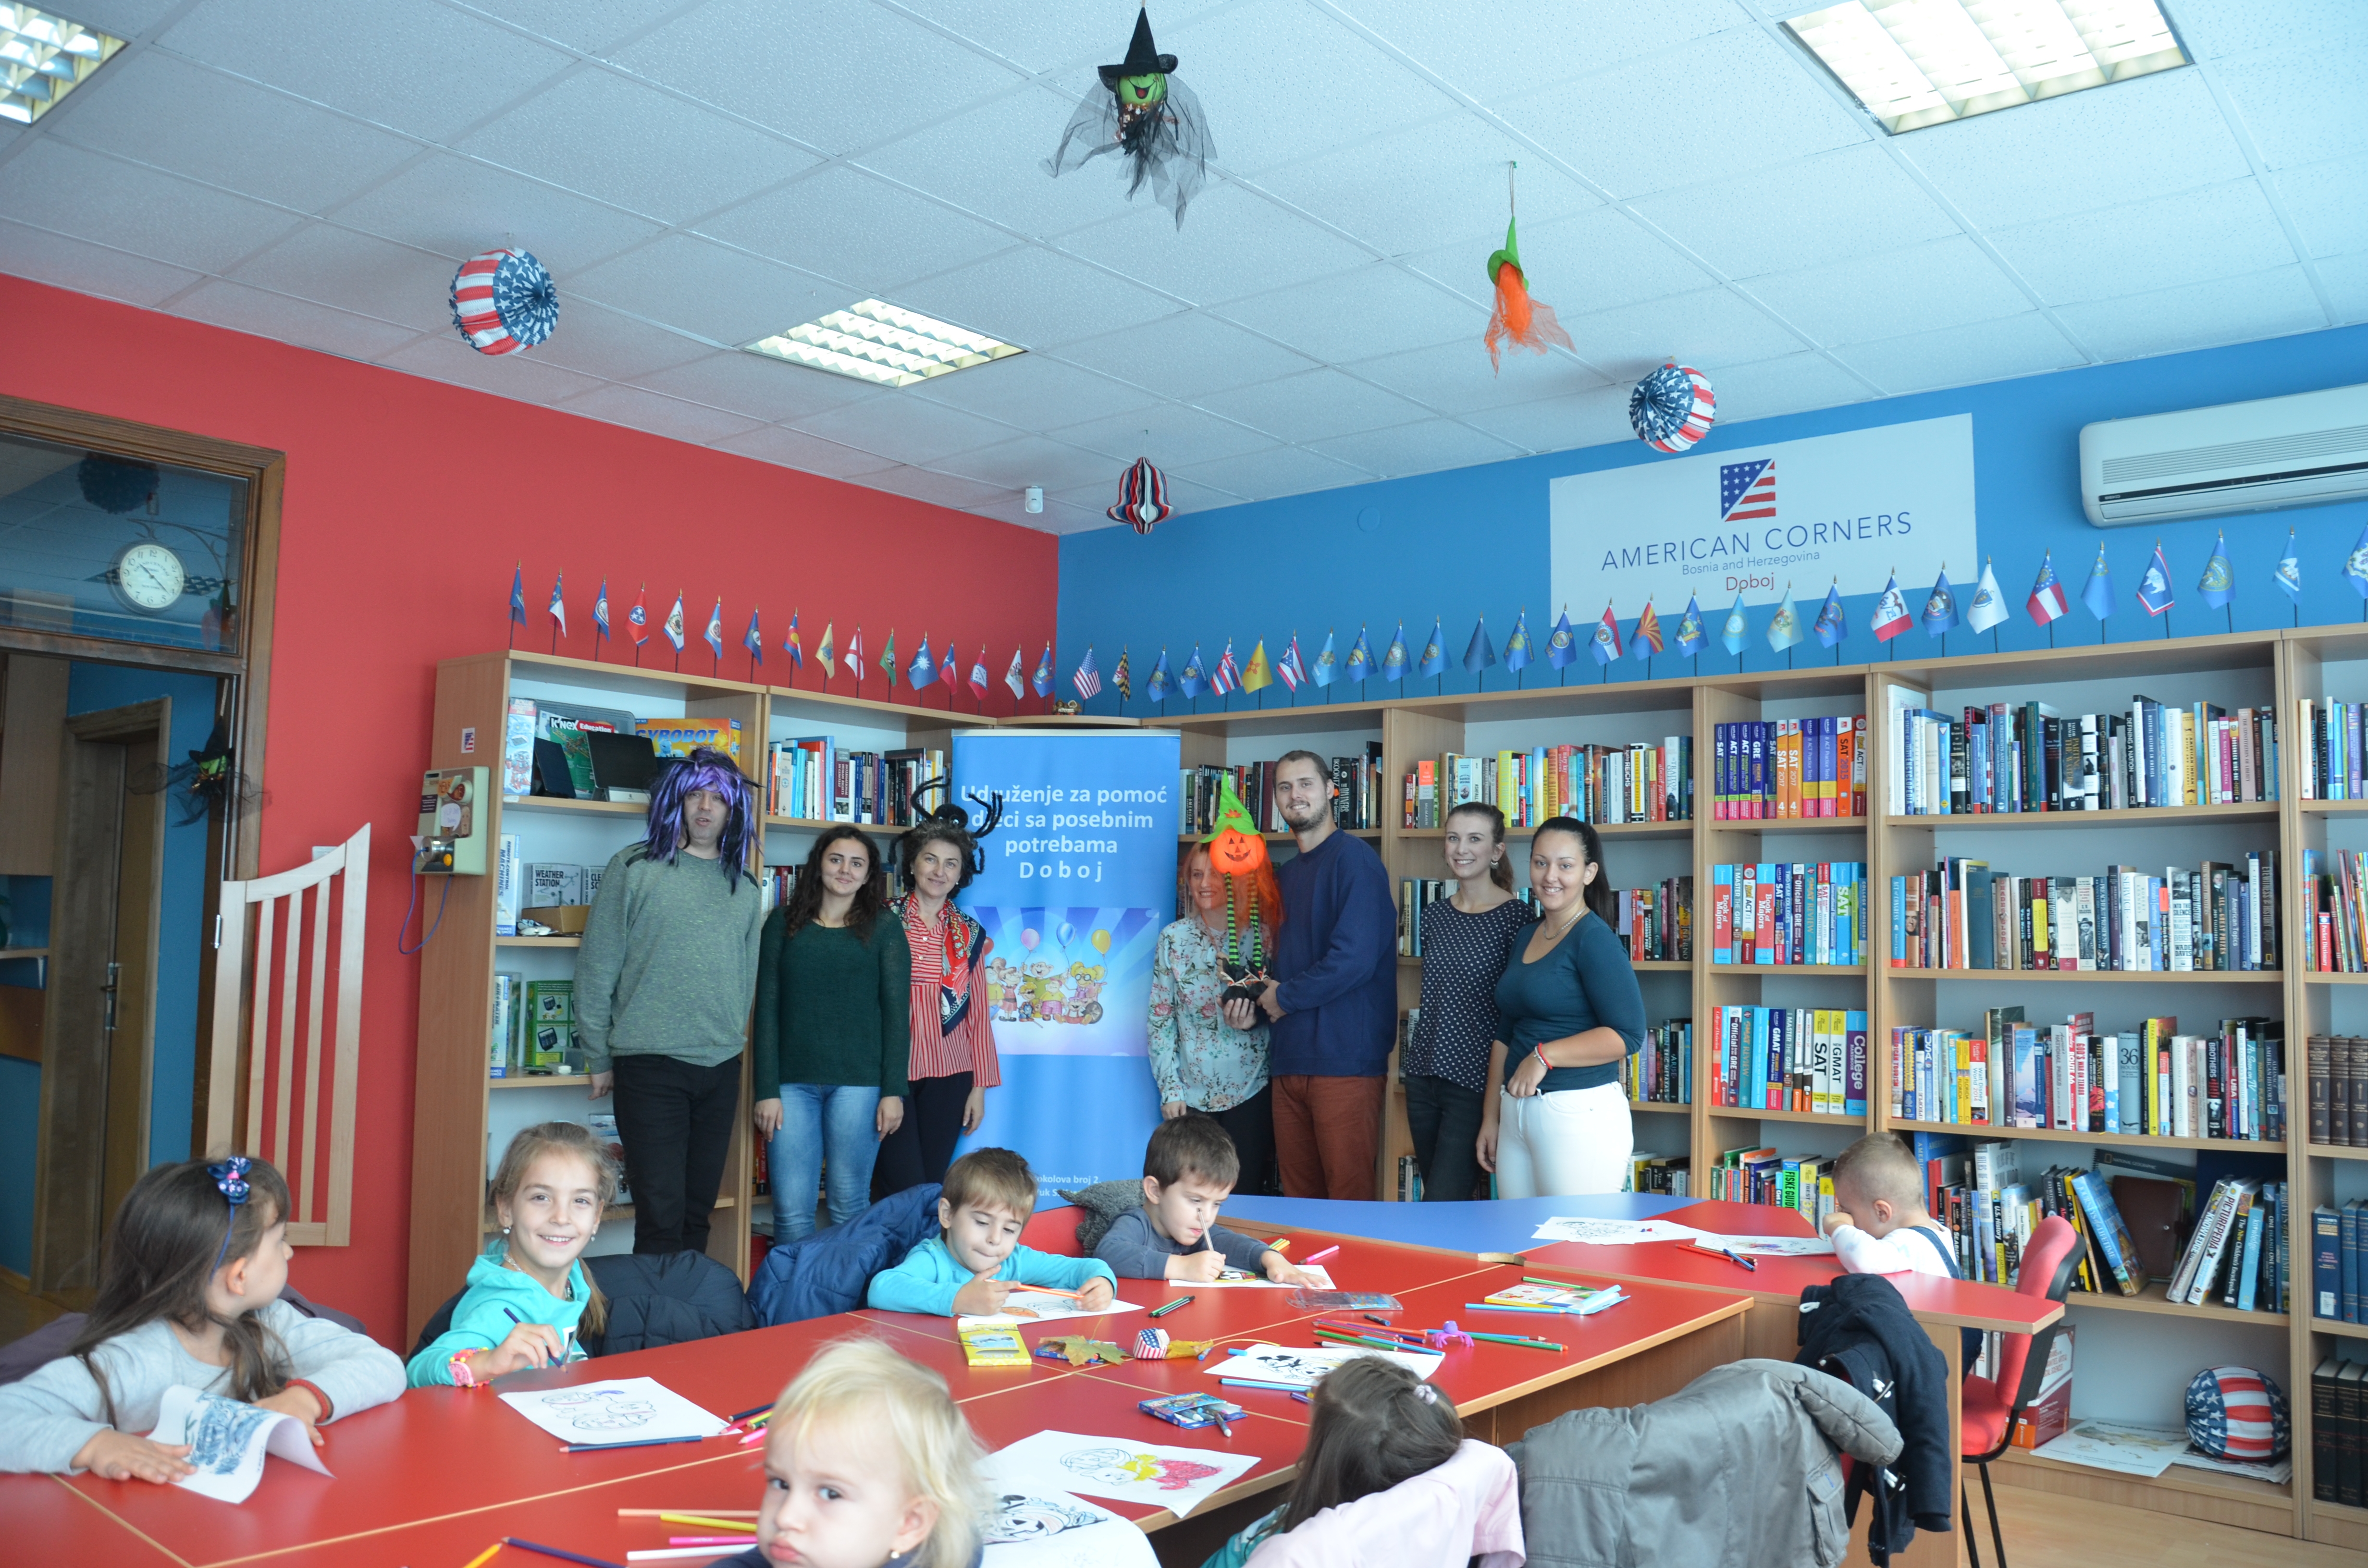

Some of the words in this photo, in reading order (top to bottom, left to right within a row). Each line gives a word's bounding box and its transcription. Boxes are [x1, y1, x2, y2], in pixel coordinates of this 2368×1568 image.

[1601, 532, 1750, 571] AMERICAN
[1764, 512, 1912, 551] CORNERS
[1681, 561, 1719, 576] Bosnia
[1723, 557, 1744, 570] and
[1747, 551, 1820, 570] Herzegovina
[1726, 572, 1775, 591] Doboj
[580, 723, 612, 733] Education
[636, 729, 719, 743] GYROBOT
[1753, 741, 1761, 759] GRE
[1840, 739, 1849, 755] SAT
[1777, 750, 1787, 769] SAT
[1789, 750, 1799, 768] SAT
[1840, 759, 1849, 780] 2015
[1905, 759, 1913, 804] ENCYCLOPEDIA
[1070, 790, 1090, 802] za
[1098, 786, 1167, 806] pomoć
[1340, 788, 1349, 812] DIVINERS
[972, 810, 1019, 828] deci
[1025, 816, 1046, 828] sa
[1052, 811, 1153, 830] posebnim
[1006, 836, 1118, 857] potrebama
[535, 870, 564, 879] WEATHER
[535, 879, 560, 888] STATION
[2261, 866, 2272, 898] EYEWITNESS
[1837, 886, 1849, 916] SAT
[2262, 906, 2272, 927] HISTORY
[1681, 926, 1690, 959] INFERNO
[1772, 1028, 1781, 1053] GMAT
[1814, 1042, 1827, 1076] SAT
[2077, 1043, 2085, 1060] GOD'S
[2121, 1048, 2139, 1065] 36
[2208, 1042, 2217, 1078] BROTHERS
[1833, 1047, 1842, 1083] GMAT
[1851, 1035, 1865, 1090] College
[2070, 1075, 2076, 1084] 66
[2113, 1157, 2131, 1165] NATIONAL
[2132, 1160, 2157, 1170] GEOGRAPHIC
[1034, 1175, 1071, 1183] okolova
[1073, 1176, 1091, 1185] broj
[1785, 1172, 1795, 1189] FISKE
[2077, 1185, 2098, 1219] JOURNEYS
[2096, 1229, 2115, 1259] LIFETIME
[2209, 1196, 2235, 1250] PICTUREPEDIA
[2190, 1212, 2215, 1257] KNOWLEDGE
[2234, 1242, 2243, 1265] Children's
[2227, 1264, 2239, 1294] Encyclopedia
